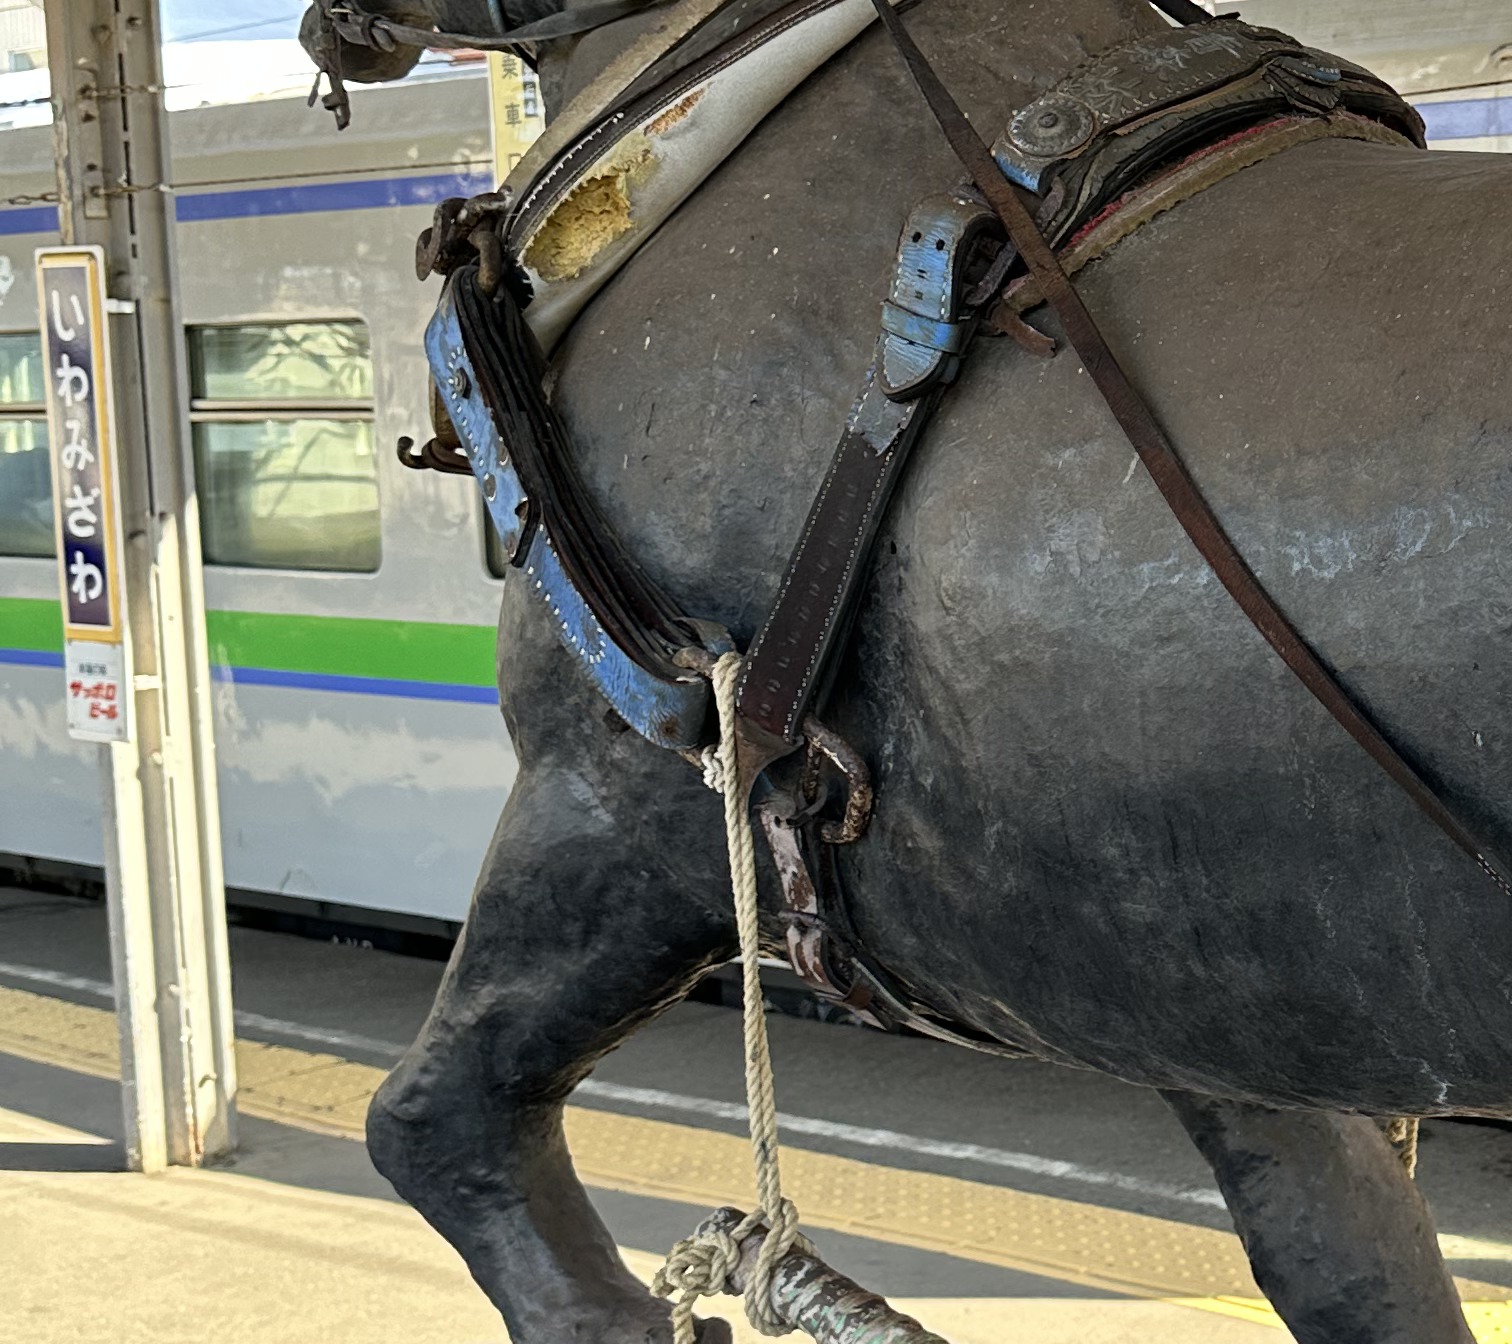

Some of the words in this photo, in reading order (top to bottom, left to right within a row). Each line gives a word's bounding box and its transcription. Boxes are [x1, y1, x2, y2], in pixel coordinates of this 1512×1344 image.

[51, 289, 103, 605] いわみざわ
